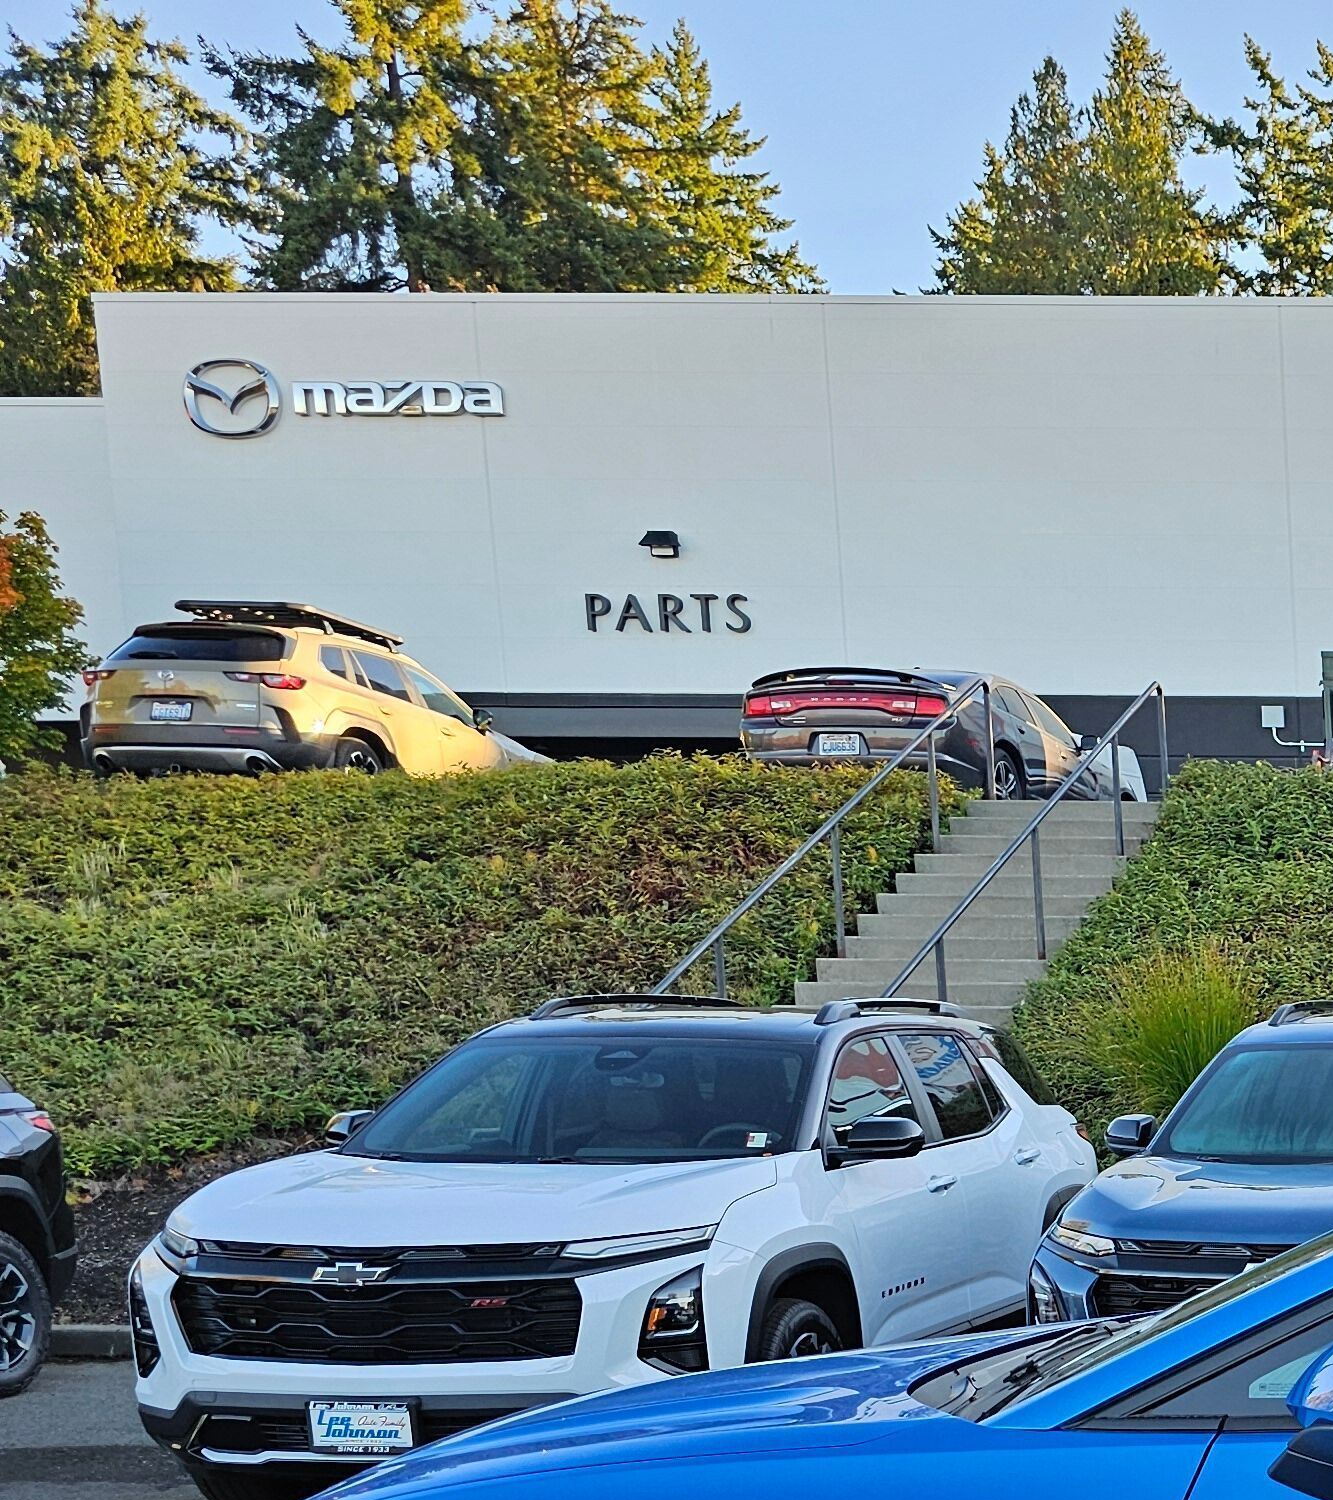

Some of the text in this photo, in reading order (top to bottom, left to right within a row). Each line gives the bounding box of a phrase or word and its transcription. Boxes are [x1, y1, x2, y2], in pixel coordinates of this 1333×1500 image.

[585, 592, 753, 635] PARTS
[317, 1410, 407, 1430] Lee Auto Family
[320, 1423, 403, 1440] Johnson
